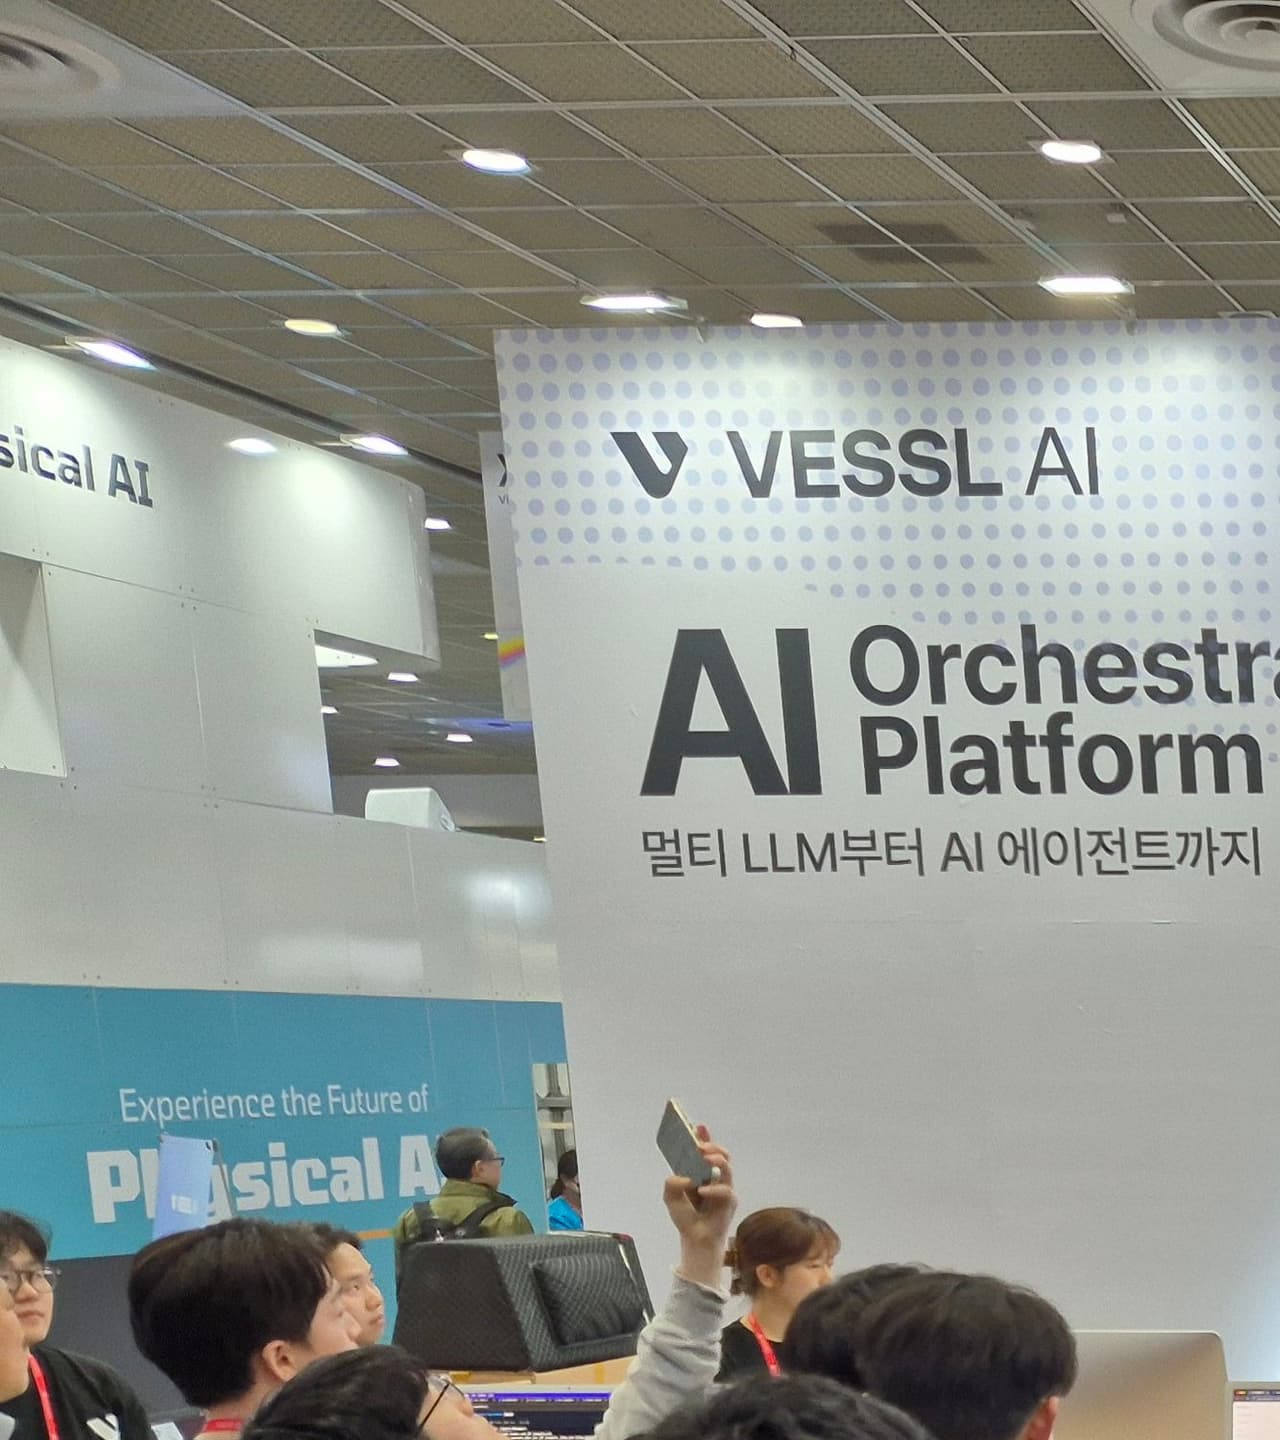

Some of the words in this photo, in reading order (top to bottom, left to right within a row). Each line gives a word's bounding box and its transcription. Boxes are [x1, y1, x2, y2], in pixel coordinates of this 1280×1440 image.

[108, 453, 153, 508] AI
[726, 427, 1003, 499] VESSL
[1026, 425, 1100, 496] AI
[639, 627, 823, 796] AI
[859, 711, 1265, 796] Platform
[642, 827, 728, 878] 멀티
[742, 827, 925, 878] LLM부터
[941, 833, 983, 872] AI
[997, 825, 1262, 877] 에이전트까지
[119, 1086, 275, 1129] Experience
[281, 1085, 322, 1116] the
[327, 1084, 402, 1116] Future
[409, 1083, 429, 1113] of
